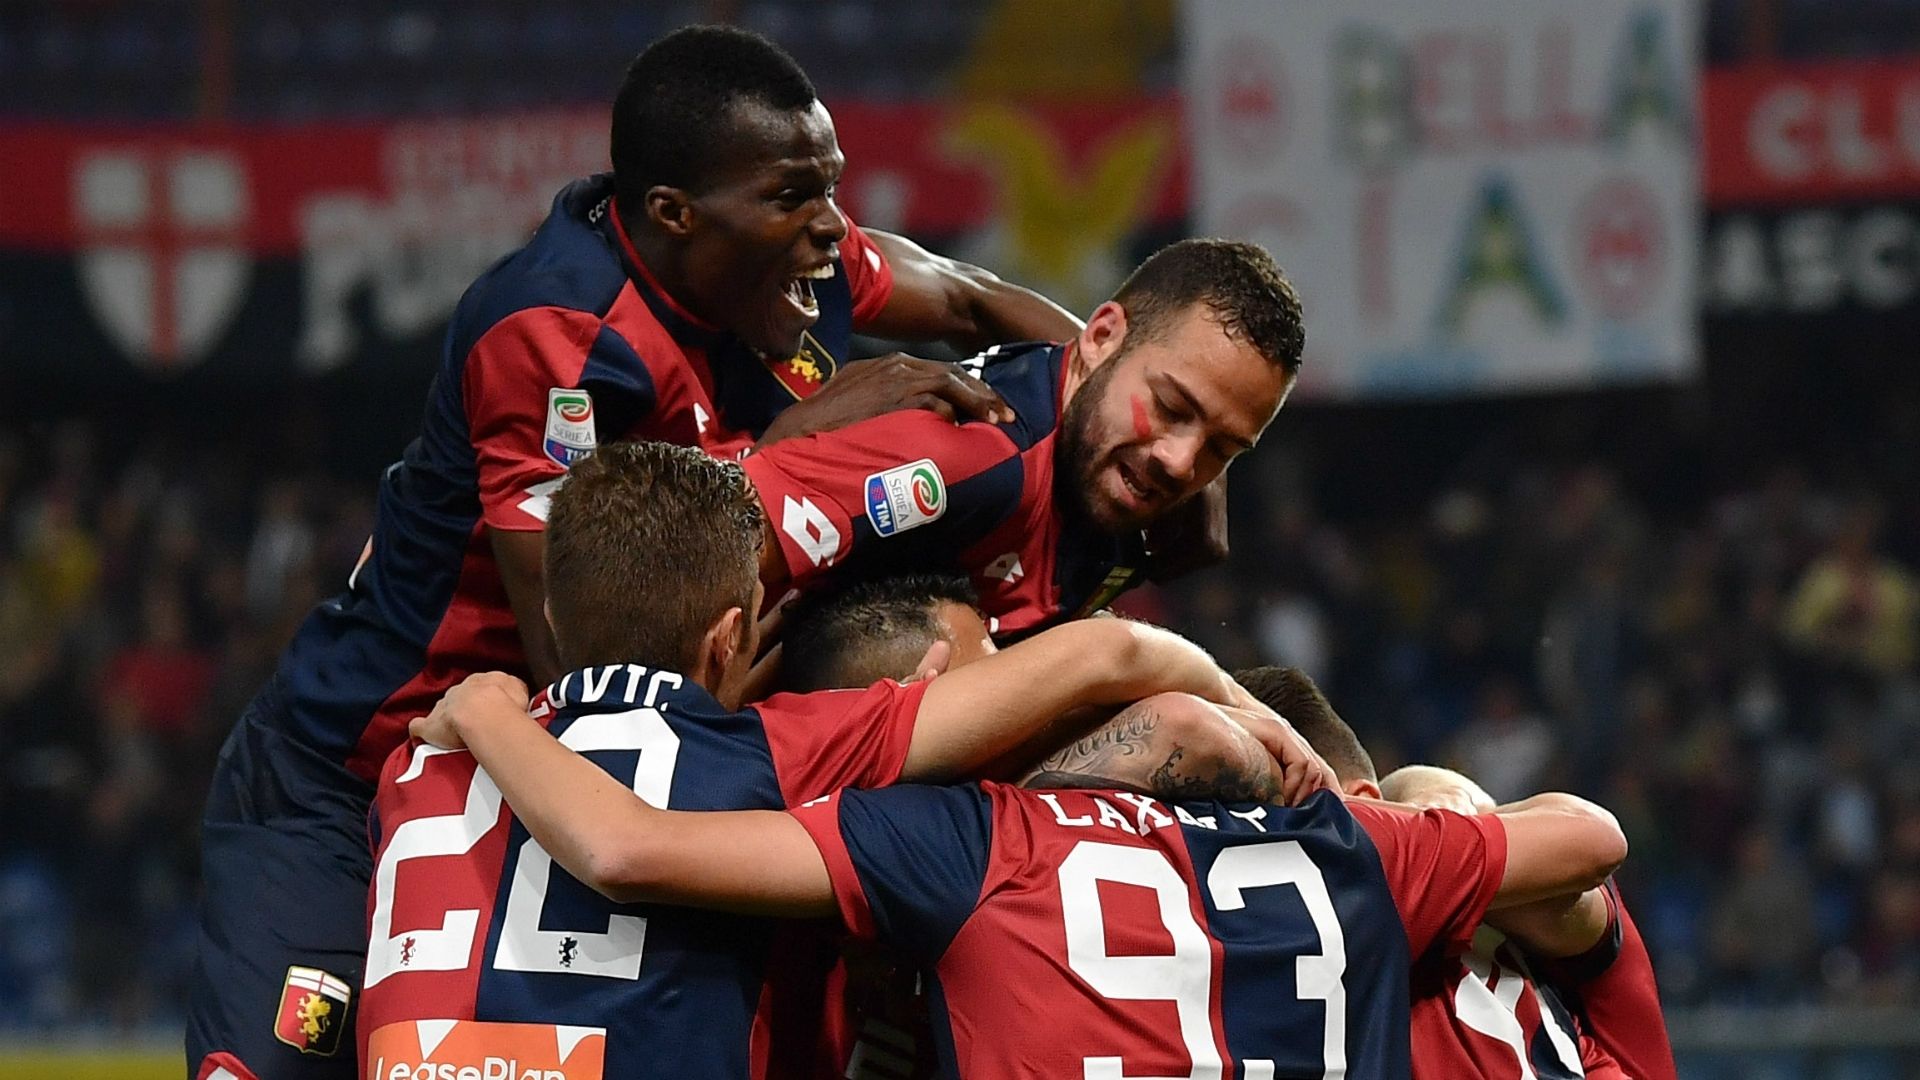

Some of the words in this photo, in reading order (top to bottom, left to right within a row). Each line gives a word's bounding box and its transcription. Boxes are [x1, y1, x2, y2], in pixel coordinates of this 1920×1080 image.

[1325, 8, 1692, 172] BELLA
[1746, 80, 1920, 183] CL
[553, 423, 581, 442] SERIE
[584, 431, 592, 444] A
[875, 499, 892, 529] TIM
[889, 478, 908, 513] SERIE
[897, 512, 910, 524] A
[1037, 792, 1268, 837] LAXAT
[1057, 839, 1348, 1080] 93
